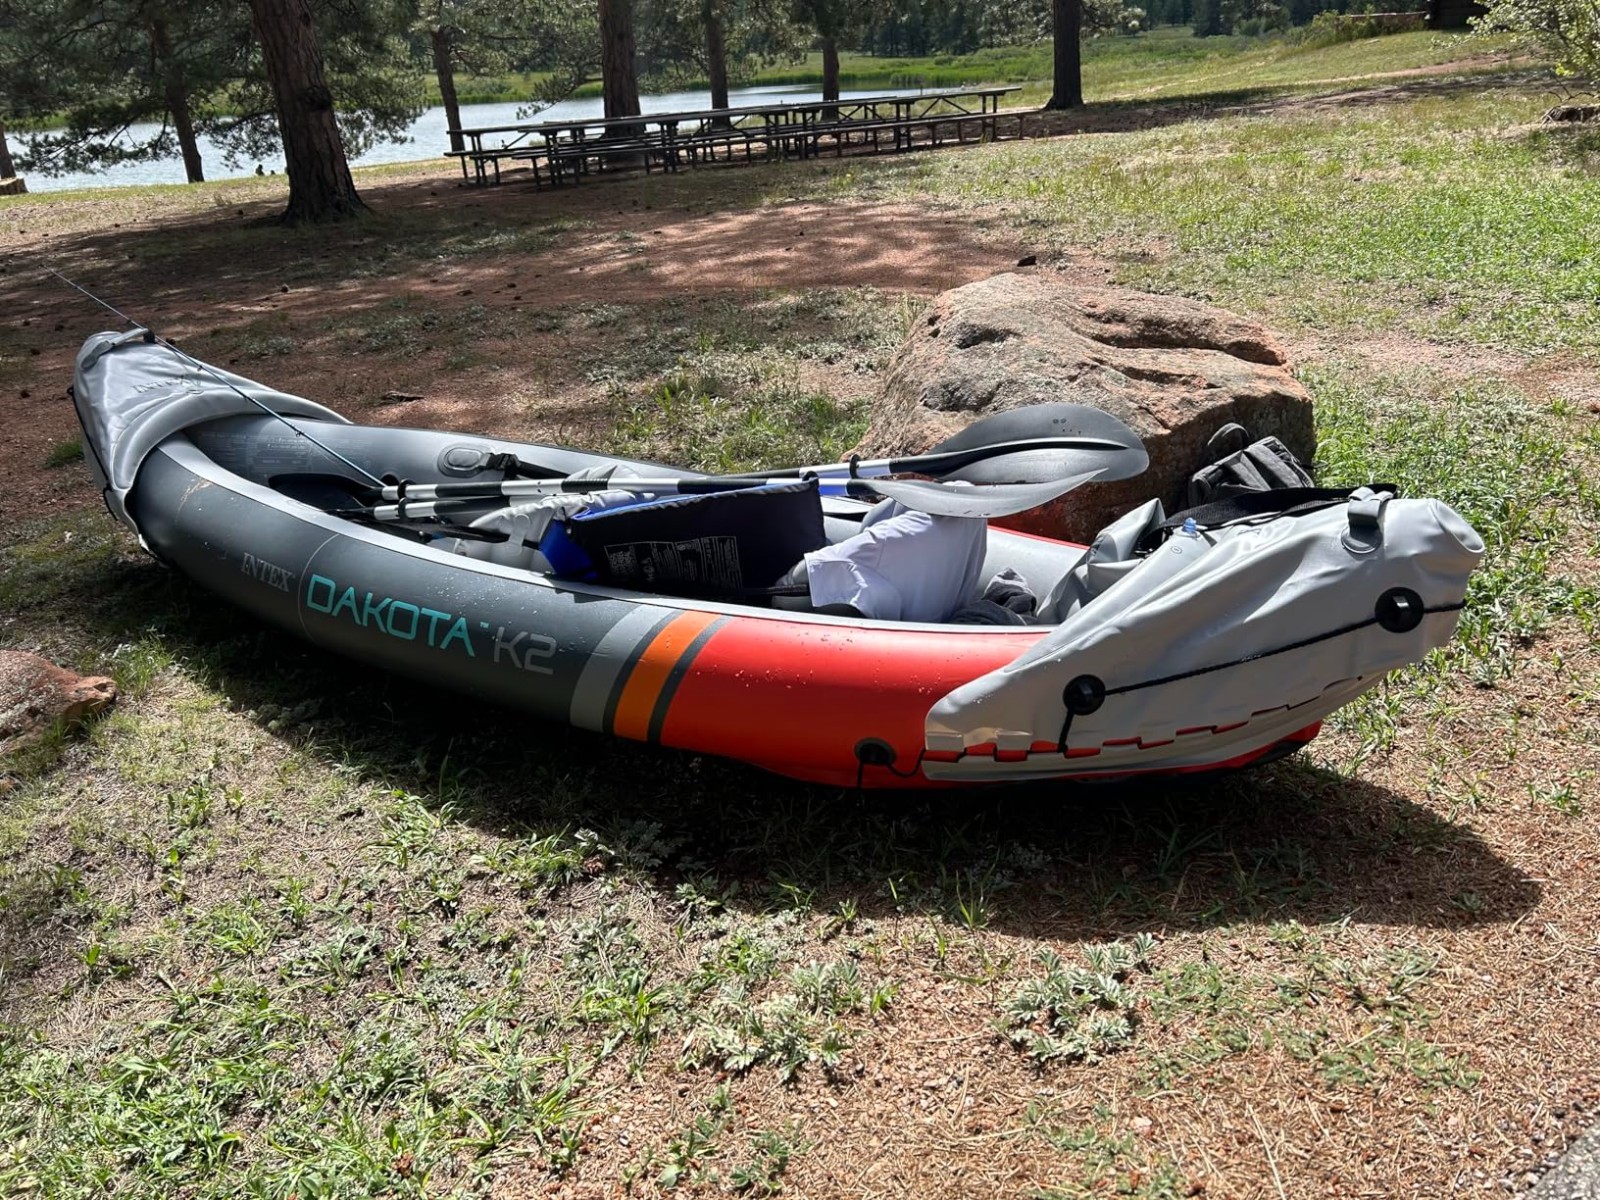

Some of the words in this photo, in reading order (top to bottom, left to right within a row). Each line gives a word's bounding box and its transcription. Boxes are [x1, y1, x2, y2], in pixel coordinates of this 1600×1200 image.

[241, 552, 293, 592] INTEX
[306, 573, 476, 658] DAKOTA
[493, 626, 557, 676] K2
